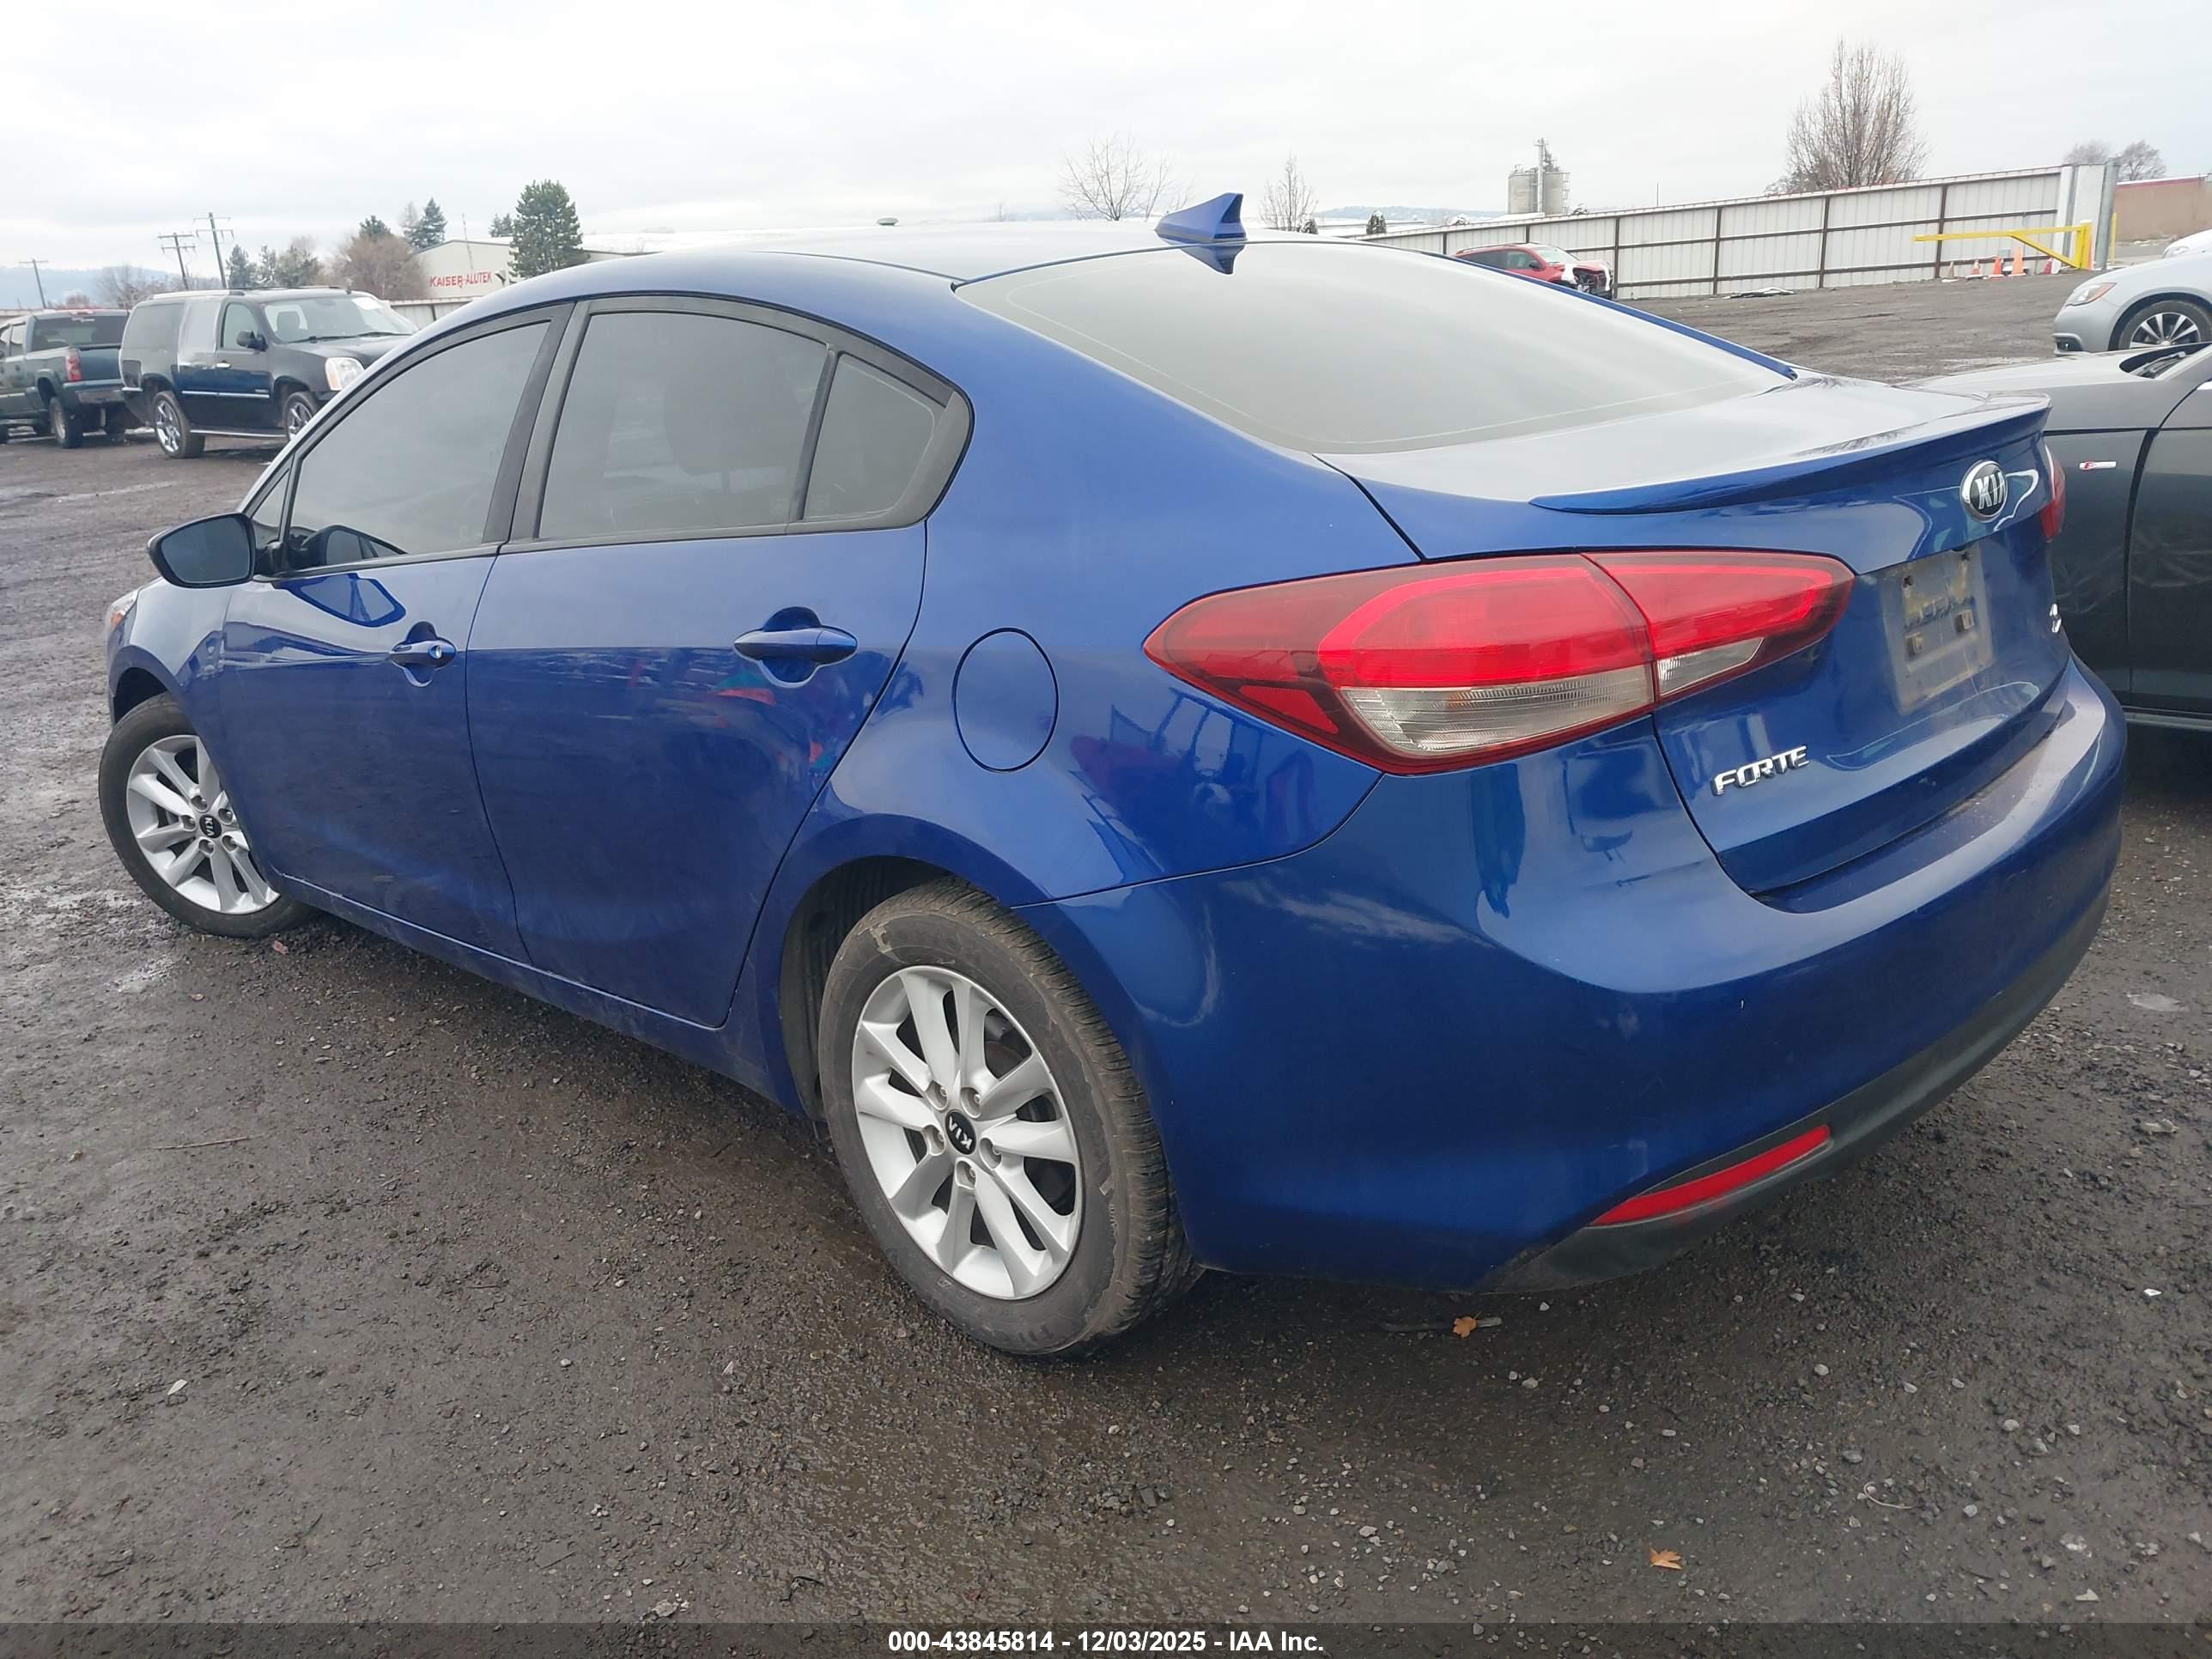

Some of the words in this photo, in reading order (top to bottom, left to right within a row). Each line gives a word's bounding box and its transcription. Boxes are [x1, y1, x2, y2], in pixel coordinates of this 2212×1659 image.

[1975, 471, 2005, 509] KIA
[1711, 745, 1809, 805] FORTE
[204, 817, 215, 836] KIA
[950, 1116, 973, 1151] KIA
